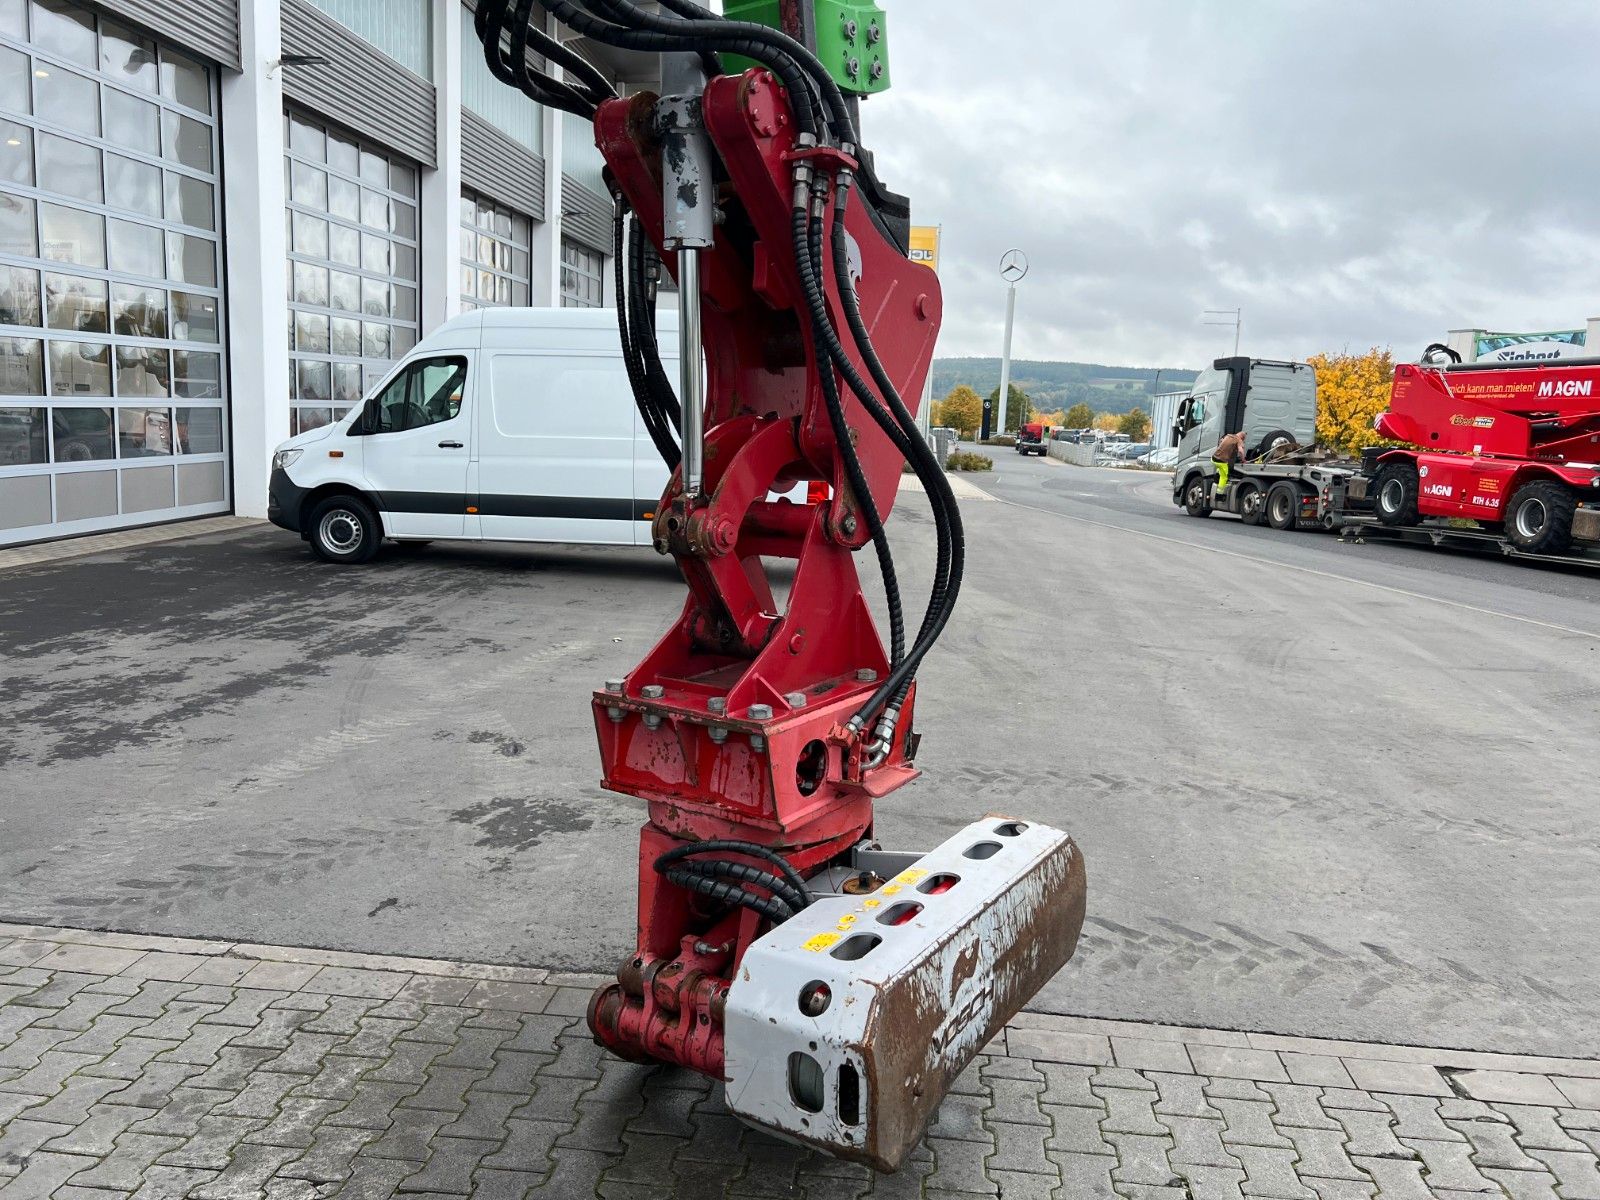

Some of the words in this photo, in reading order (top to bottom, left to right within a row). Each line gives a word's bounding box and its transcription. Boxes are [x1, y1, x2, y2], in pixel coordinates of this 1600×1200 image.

[1467, 384, 1485, 393] kann
[1505, 382, 1535, 393] mieten!
[1538, 380, 1592, 397] MAGNI
[1472, 496, 1484, 505] RTH
[1485, 497, 1500, 508] 6.35
